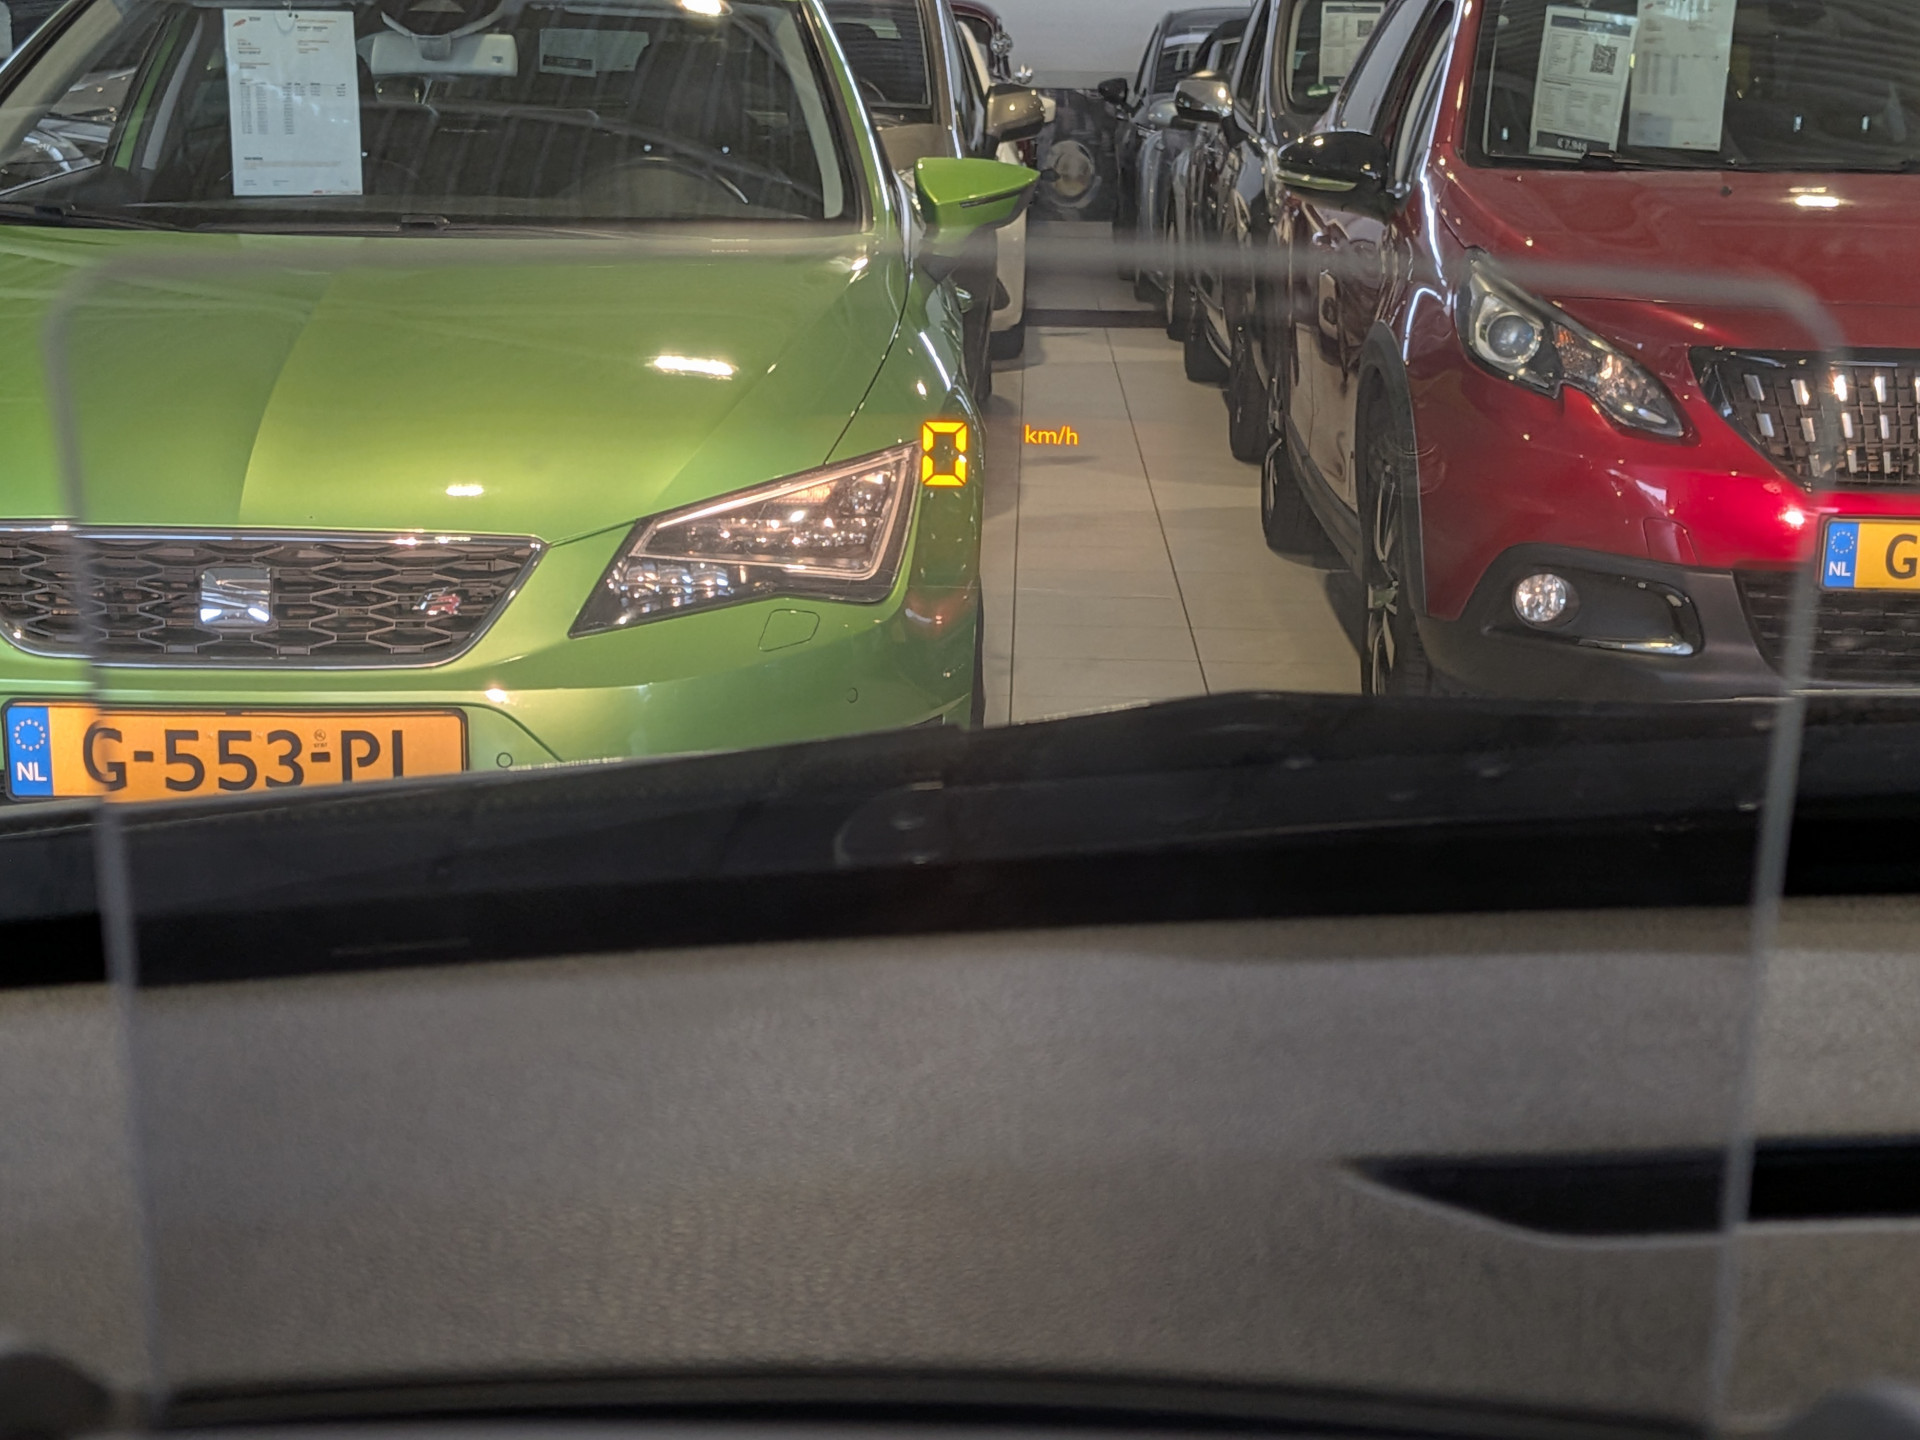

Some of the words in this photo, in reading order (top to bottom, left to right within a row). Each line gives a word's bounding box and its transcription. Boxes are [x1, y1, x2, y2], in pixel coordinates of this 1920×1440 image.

[921, 421, 967, 487] 0
[1024, 424, 1079, 446] km/h
[1829, 561, 1851, 577] NL
[16, 761, 48, 782] NL
